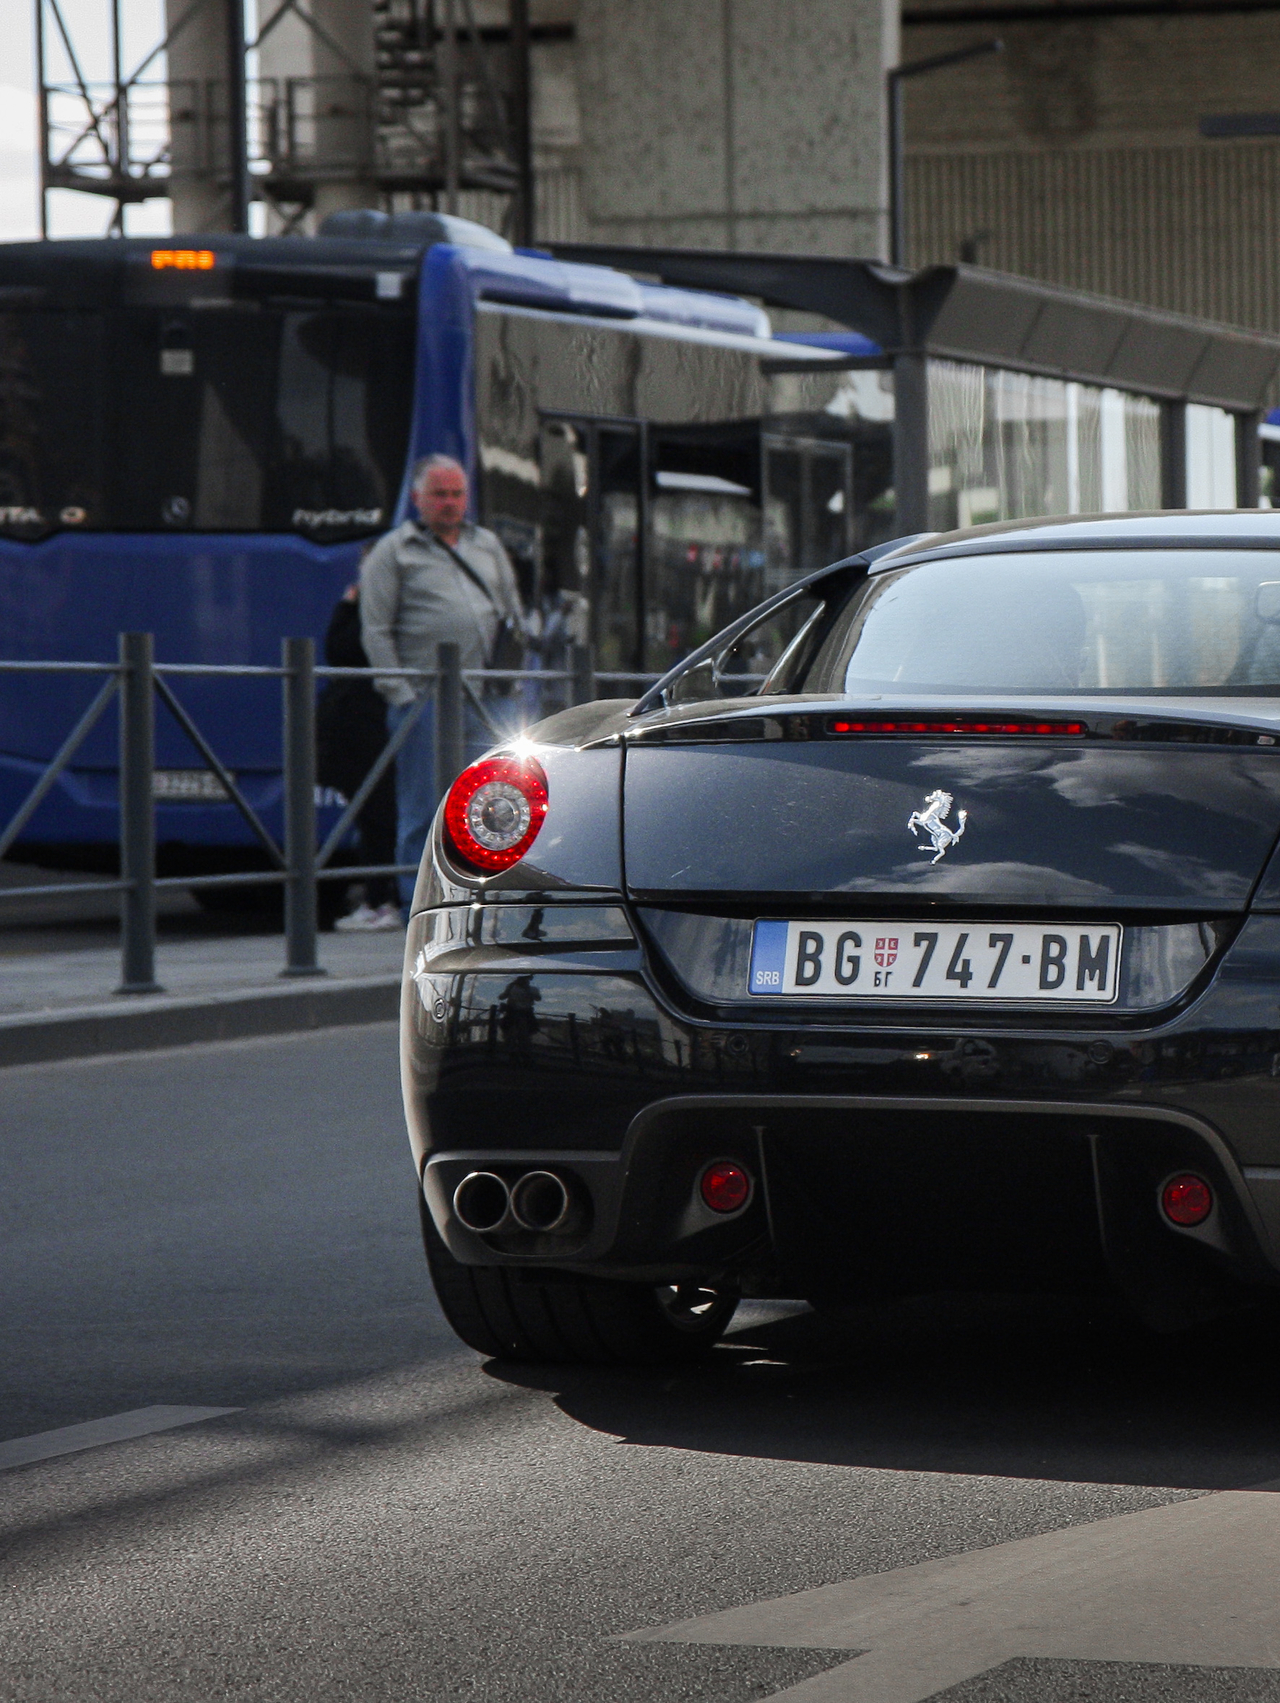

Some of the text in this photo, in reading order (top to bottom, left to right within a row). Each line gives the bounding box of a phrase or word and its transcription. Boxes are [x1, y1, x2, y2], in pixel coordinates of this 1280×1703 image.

[292, 507, 382, 529] hybrid
[795, 931, 862, 986] BG
[756, 971, 780, 985] SRB
[874, 971, 893, 987] БГ
